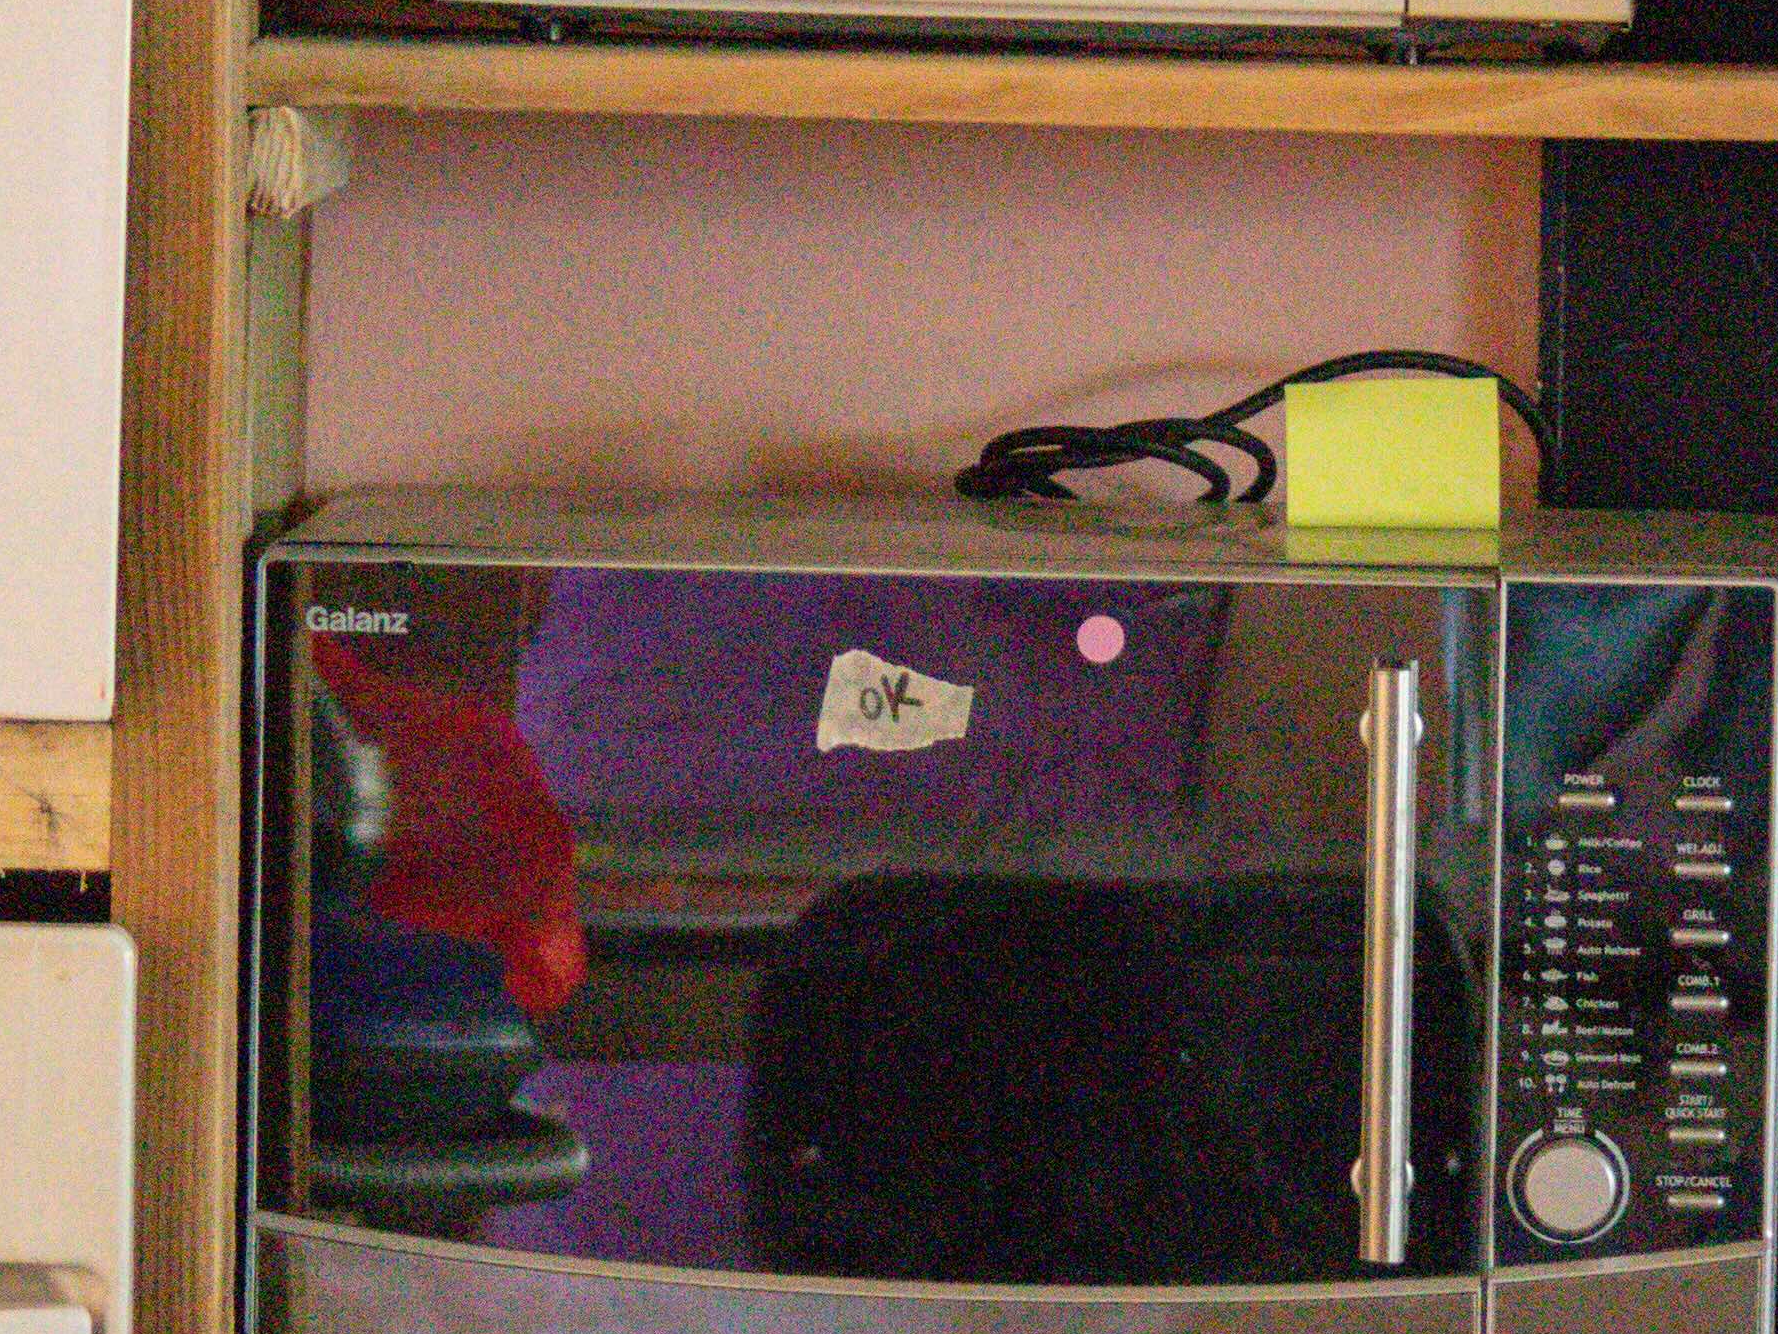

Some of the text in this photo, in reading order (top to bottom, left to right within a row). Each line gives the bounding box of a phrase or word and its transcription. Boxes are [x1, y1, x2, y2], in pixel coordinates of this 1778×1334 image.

[304, 605, 410, 635] Galanz
[859, 669, 925, 723] OK
[1563, 772, 1604, 786] POWER
[1683, 775, 1721, 789] CLOCK
[1575, 998, 1620, 1011] Chicken
